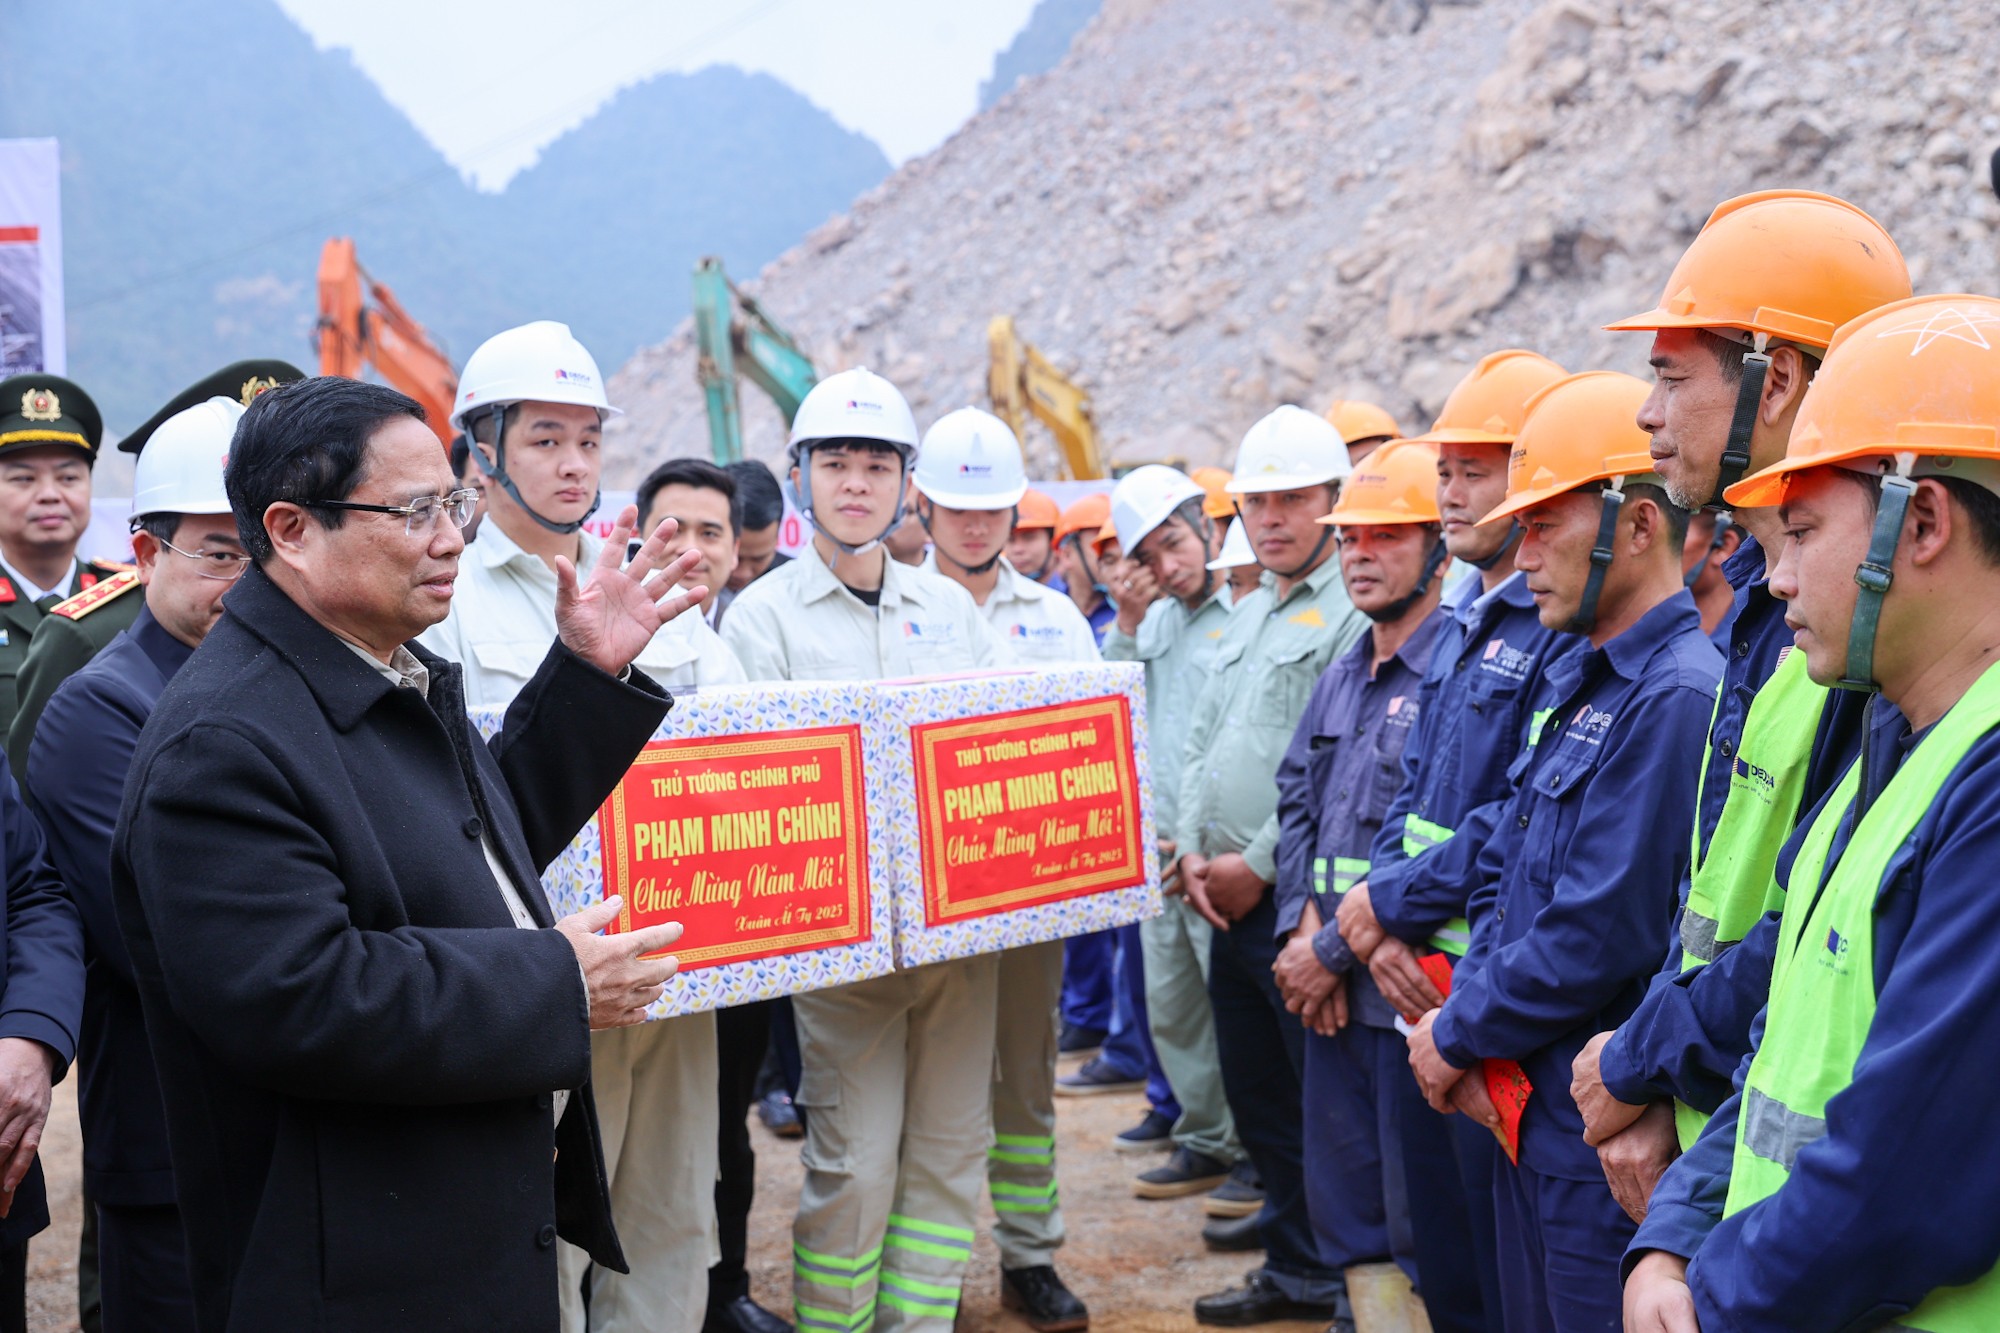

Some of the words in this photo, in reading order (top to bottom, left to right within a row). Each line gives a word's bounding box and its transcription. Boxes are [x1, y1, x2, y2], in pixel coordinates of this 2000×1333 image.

[955, 741, 982, 767] THỦ
[1029, 733, 1070, 756] CHÍNH
[1071, 722, 1097, 748] PHỦ
[651, 769, 683, 798] THỦ
[686, 768, 737, 795] TƯỚNG
[740, 765, 788, 789] CHÍNH
[791, 756, 821, 784] PHỦ
[943, 781, 1004, 824] PHẠM
[1006, 771, 1058, 811] MINH
[1061, 757, 1118, 801] CHÍNH
[634, 817, 705, 866] PHẠM
[711, 809, 771, 853] MINH
[777, 797, 842, 844] CHÍNH
[946, 834, 987, 867] Chúc
[989, 826, 1037, 858] Mừng
[1039, 817, 1080, 848] Năm
[1098, 848, 1122, 864] 2025
[633, 877, 682, 914] Chúc
[684, 870, 743, 908] Mừng
[748, 862, 796, 898] Năm
[735, 914, 771, 932] Xuân
[815, 904, 843, 920] 2025
